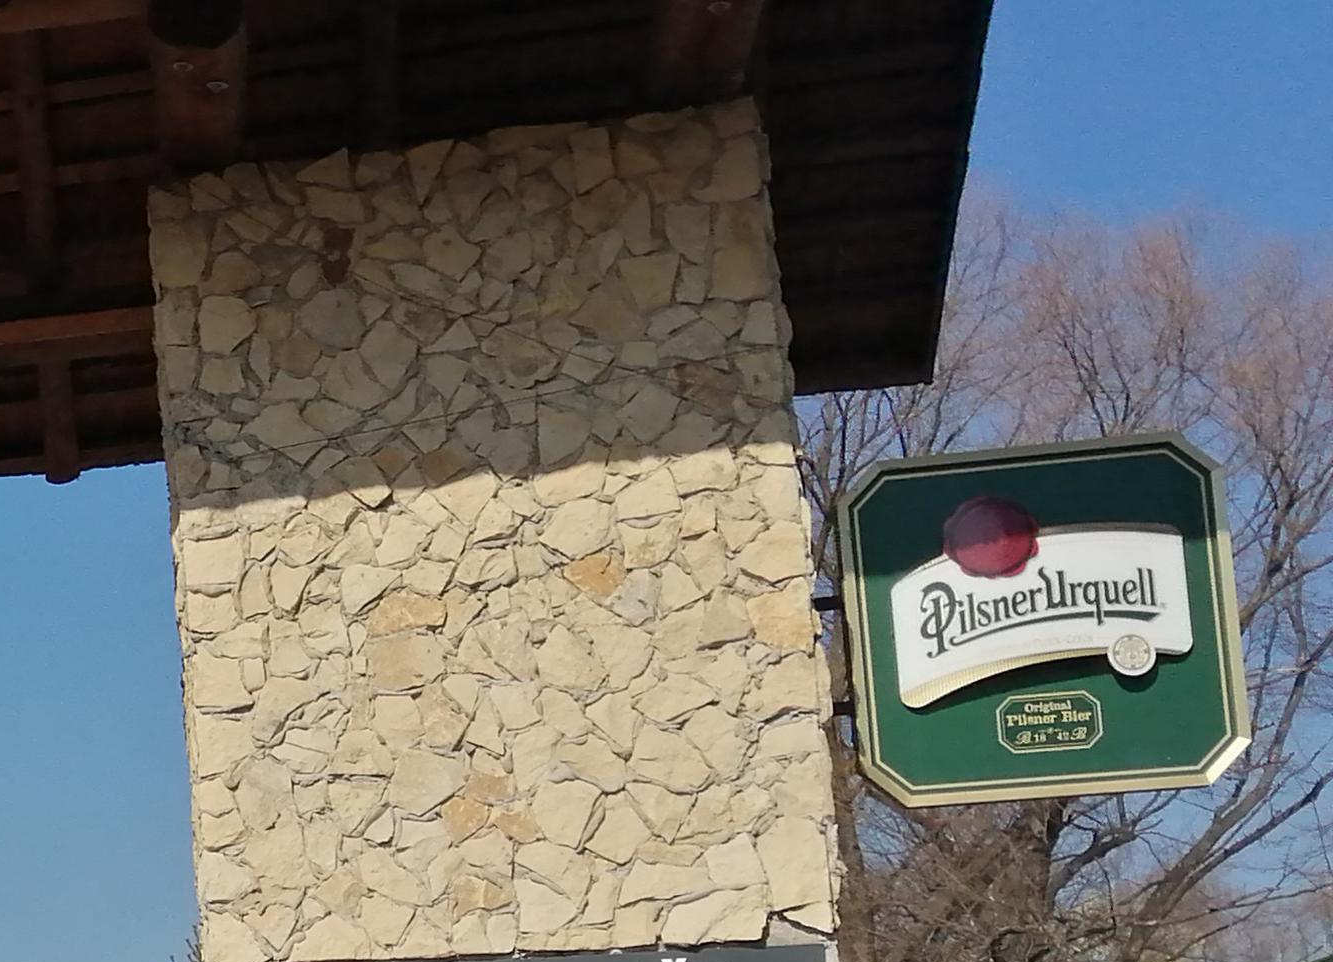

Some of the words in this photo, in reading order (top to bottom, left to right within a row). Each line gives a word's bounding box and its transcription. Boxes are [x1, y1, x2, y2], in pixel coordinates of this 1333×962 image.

[920, 581, 1042, 658] Pilsner
[1039, 566, 1157, 626] Urquell
[1024, 700, 1071, 713] Original
